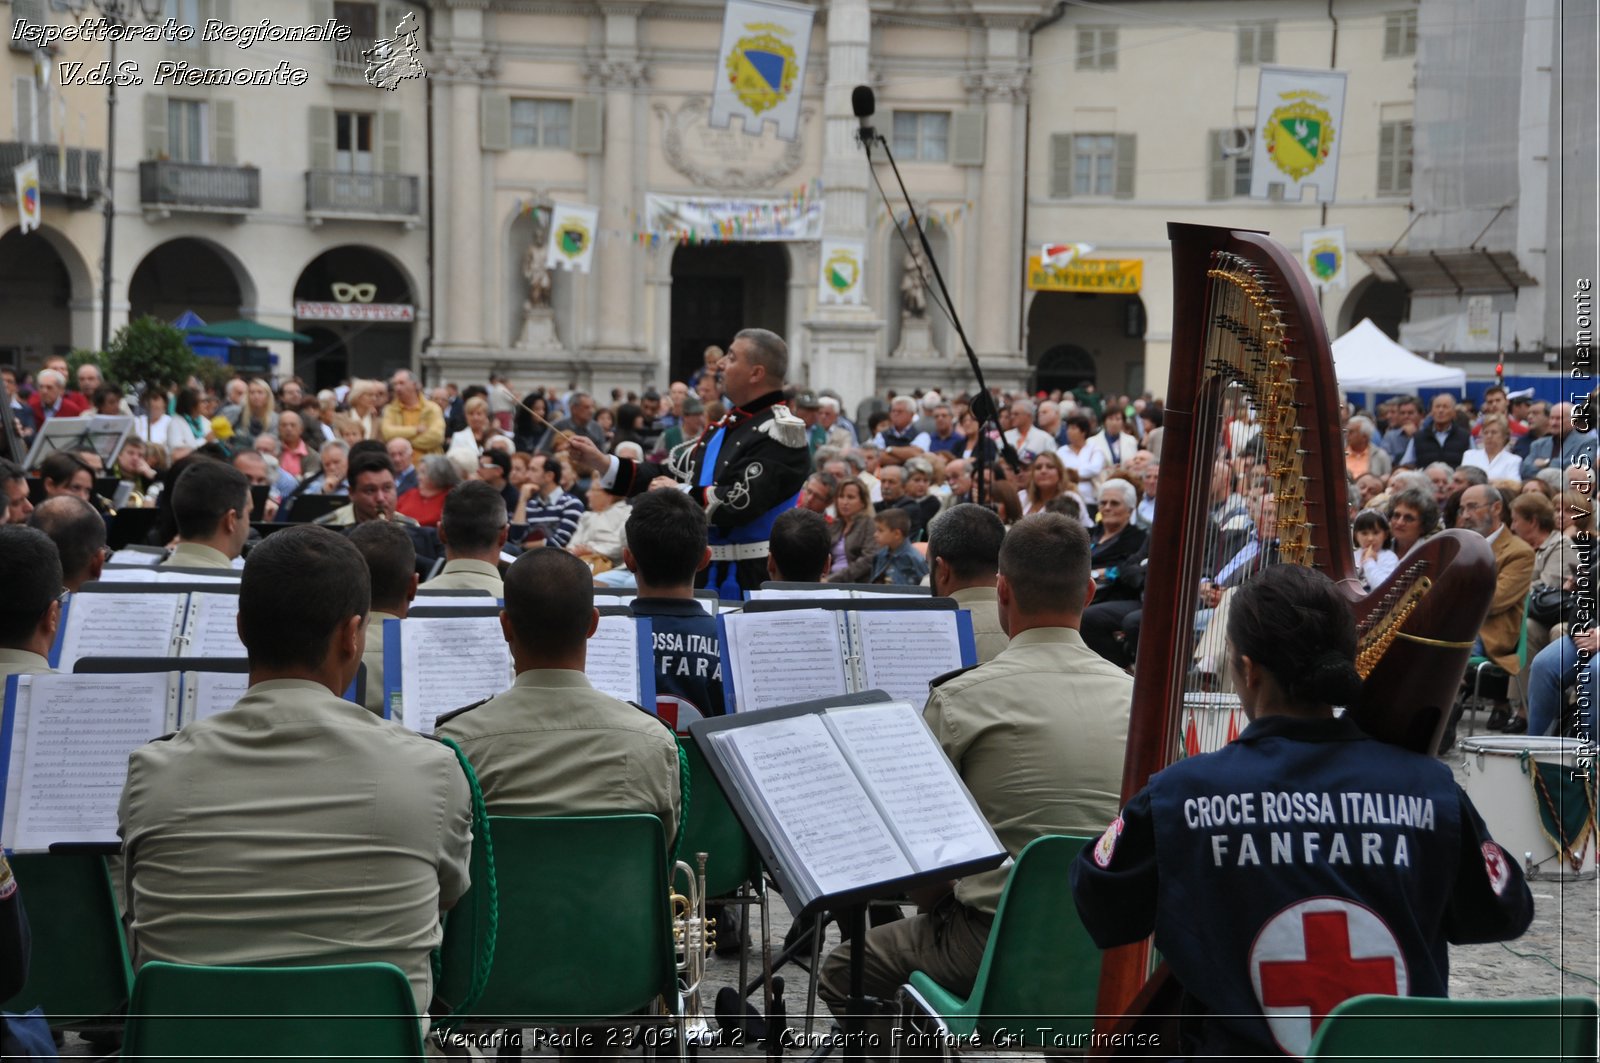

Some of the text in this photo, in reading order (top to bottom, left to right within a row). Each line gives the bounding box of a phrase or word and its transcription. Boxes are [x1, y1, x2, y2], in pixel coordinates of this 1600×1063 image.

[1033, 271, 1137, 289] BENEFICENZA
[300, 304, 411, 319] FOTO OTTICA
[652, 632, 720, 656] OSSA ITALI
[1184, 791, 1435, 831] CROCE ROSSA ITALIANA
[1211, 832, 1410, 867] FANFARA
